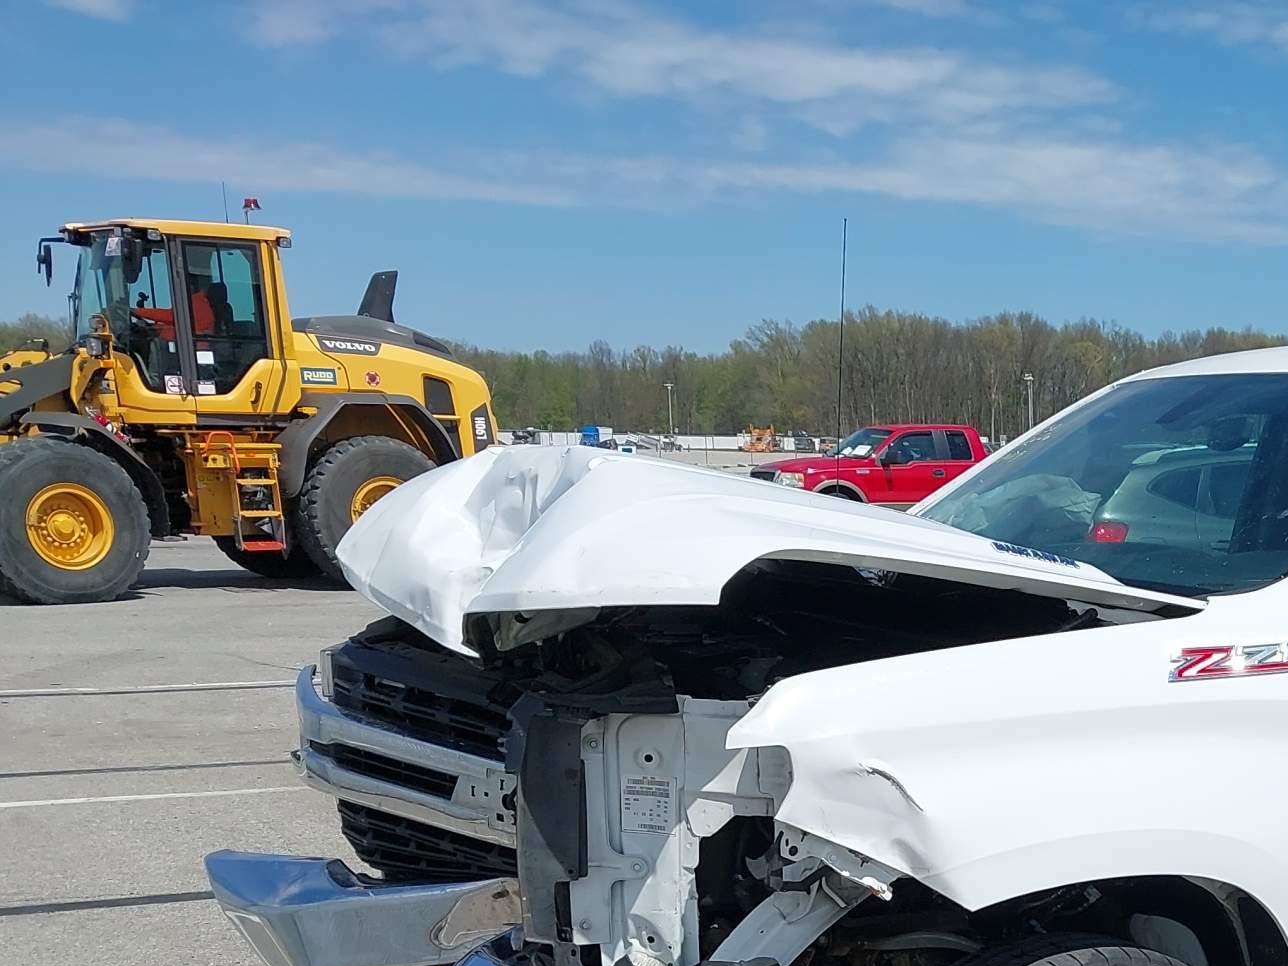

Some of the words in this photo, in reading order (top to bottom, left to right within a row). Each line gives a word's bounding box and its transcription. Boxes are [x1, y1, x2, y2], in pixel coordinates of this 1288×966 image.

[321, 340, 376, 352] VOLVO
[303, 371, 334, 382] RUDD
[474, 417, 487, 440] L90H
